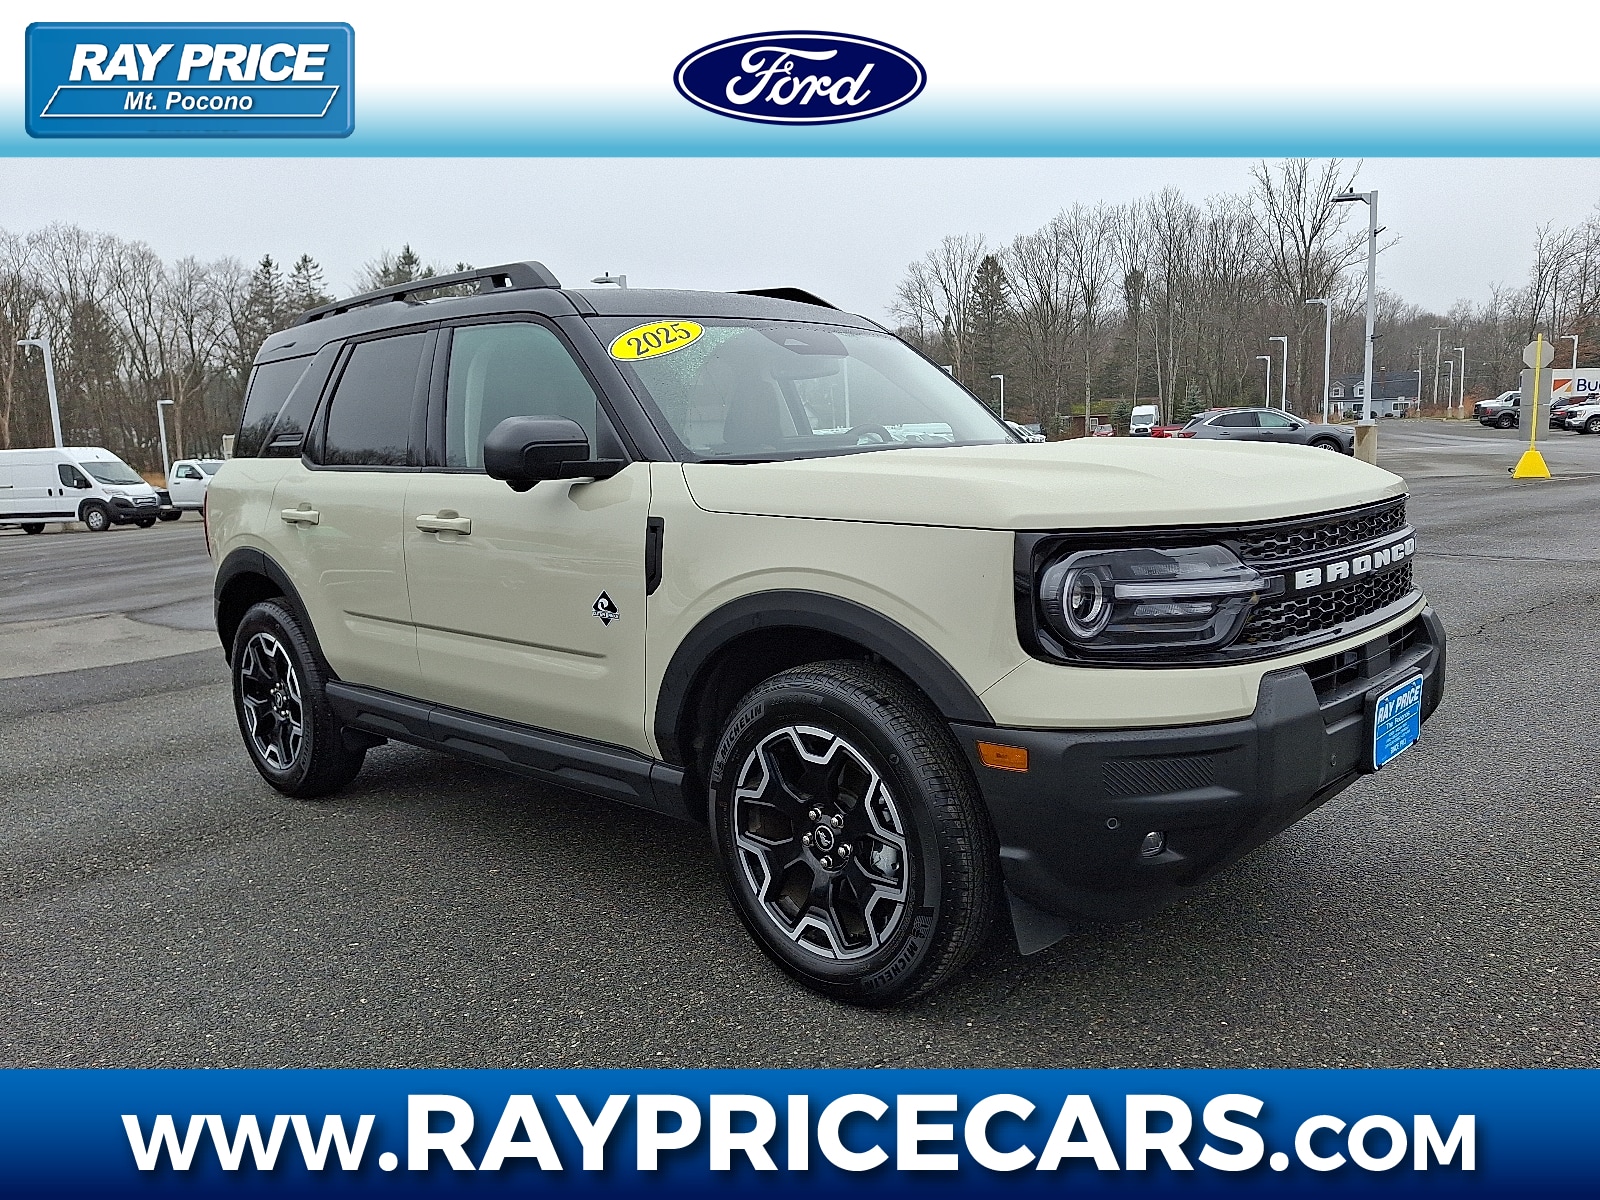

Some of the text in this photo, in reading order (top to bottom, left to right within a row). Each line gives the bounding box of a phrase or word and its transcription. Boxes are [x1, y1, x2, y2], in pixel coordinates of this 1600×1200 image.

[627, 323, 691, 356] 2025
[1576, 378, 1600, 392] Bu
[1295, 538, 1415, 590] BRONCO
[1378, 685, 1421, 724] RAY PRICE
[720, 703, 763, 758] MICHELIN
[863, 940, 919, 990] MICHELIN
